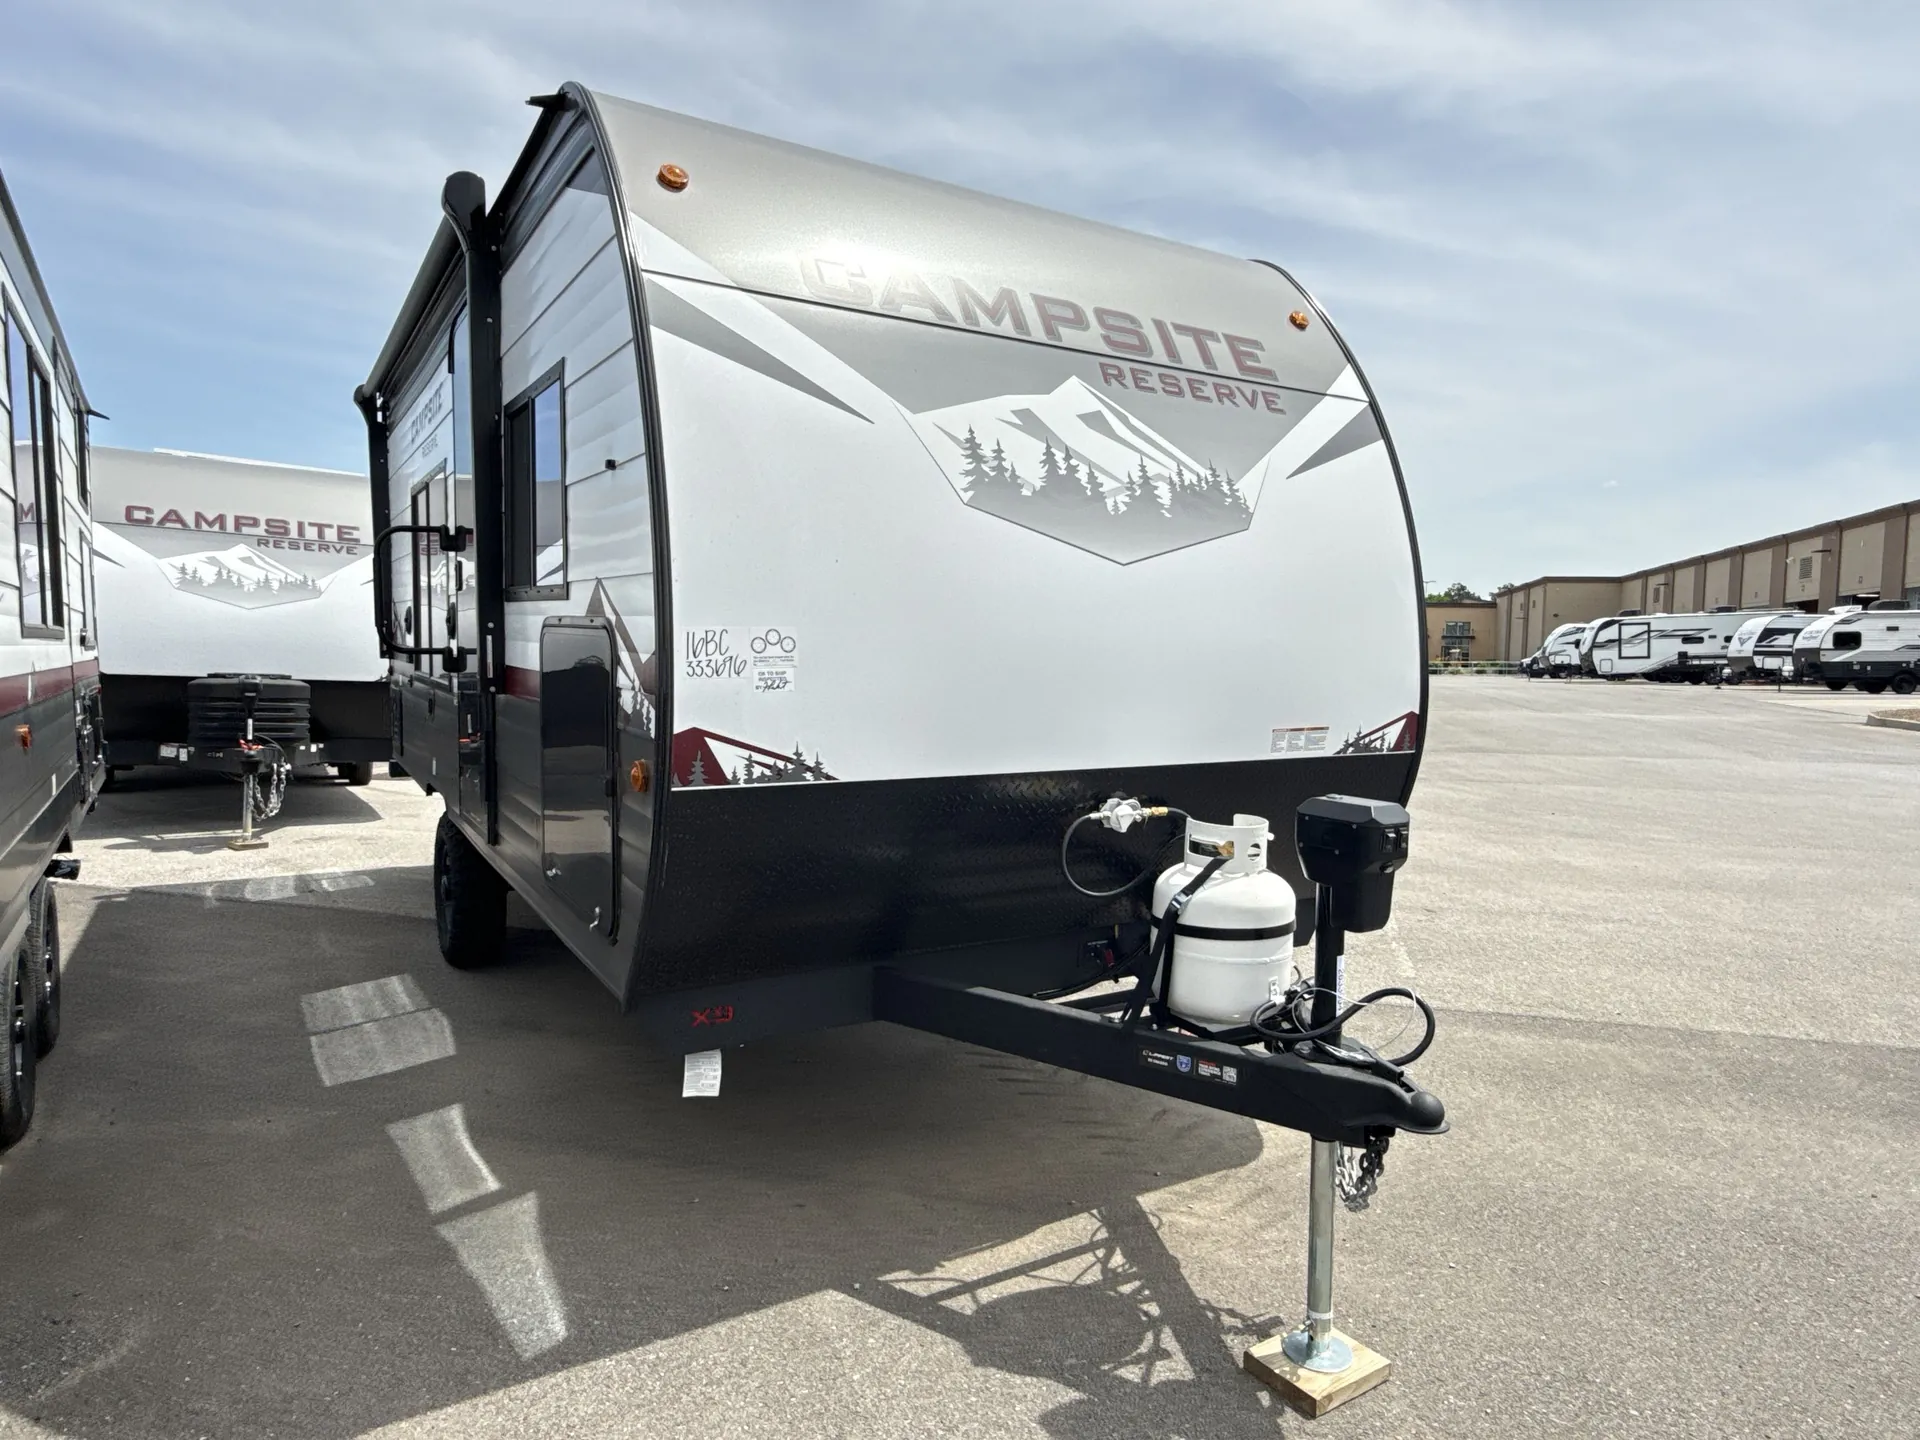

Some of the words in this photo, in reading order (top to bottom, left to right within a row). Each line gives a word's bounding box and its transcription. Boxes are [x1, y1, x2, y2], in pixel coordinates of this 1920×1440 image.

[801, 257, 1279, 382] CAMPSITE
[1099, 361, 1287, 415] RESERVE
[125, 504, 361, 544] CAMPSITE
[256, 537, 358, 556] RESERVE
[686, 628, 730, 660] 16BC
